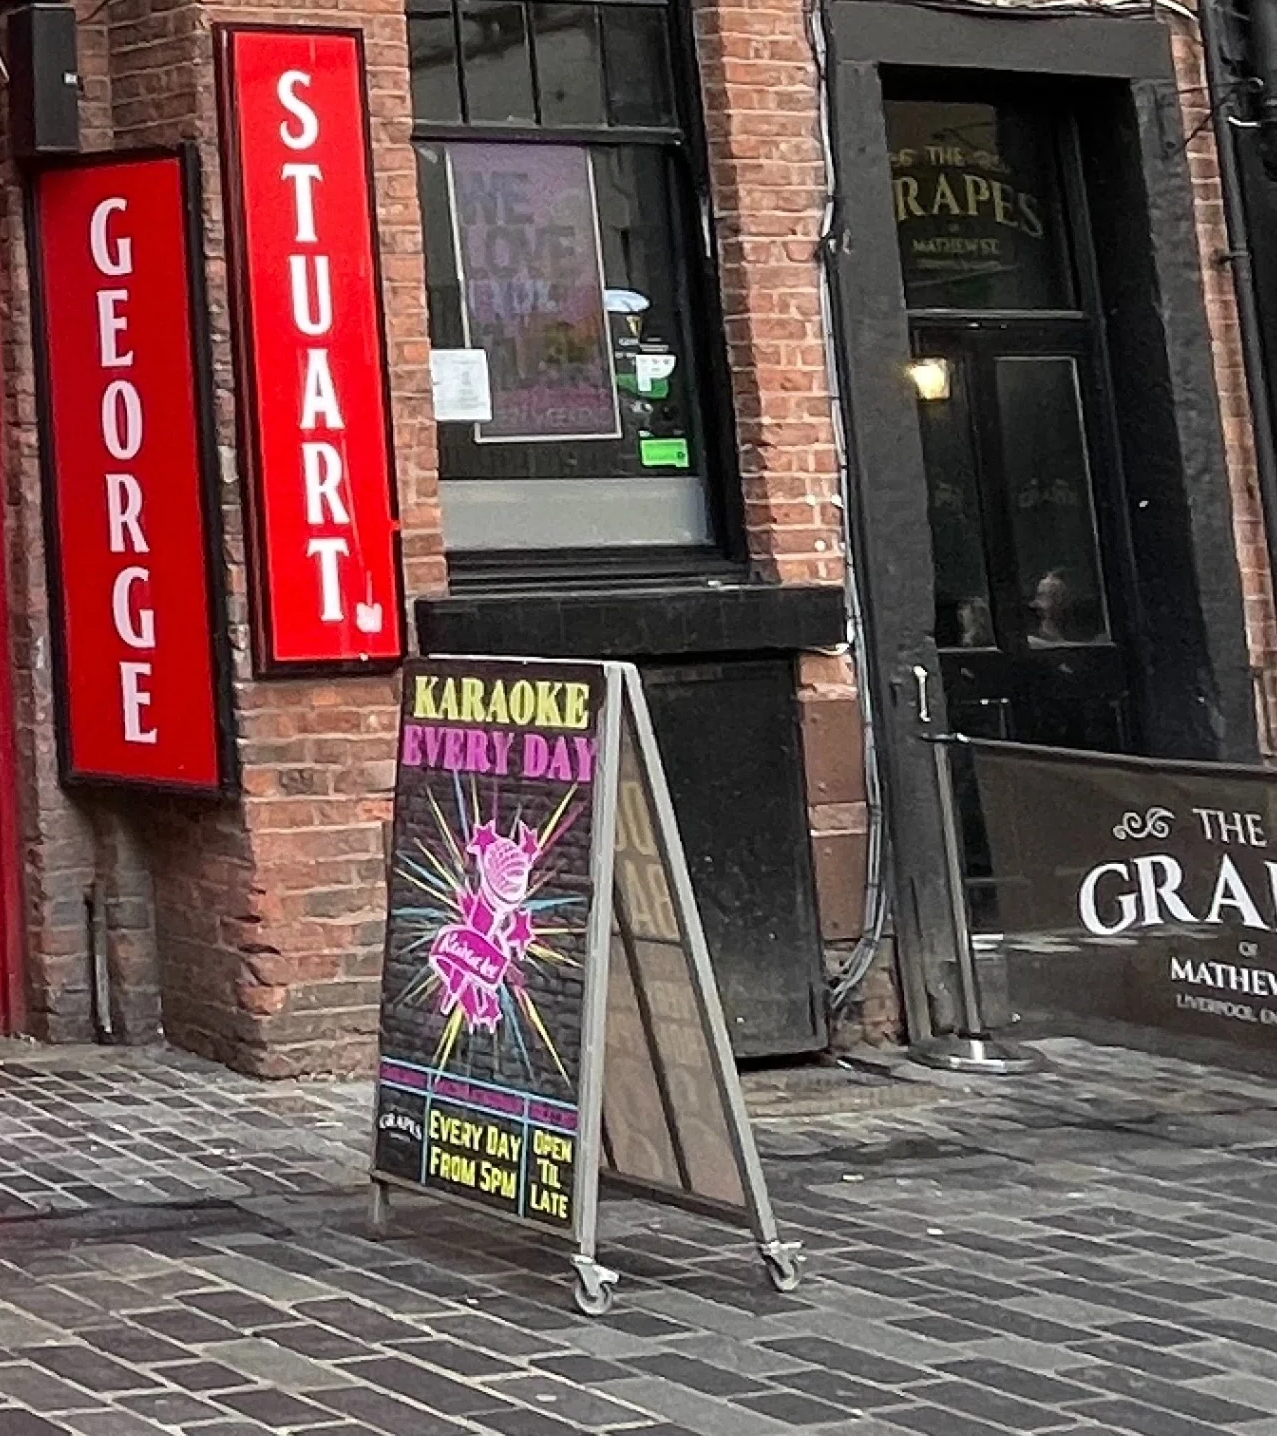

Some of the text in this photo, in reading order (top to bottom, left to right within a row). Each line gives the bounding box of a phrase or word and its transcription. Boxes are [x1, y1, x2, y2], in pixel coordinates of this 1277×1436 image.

[924, 146, 965, 167] THE
[892, 173, 1044, 239] RAPES
[277, 70, 351, 624] STUART
[89, 197, 158, 746] GEORGE
[413, 675, 589, 730] KARAOKE
[402, 724, 598, 783] EVERY DAY
[1192, 807, 1267, 847] THE
[1079, 853, 1277, 935] GRA
[430, 1110, 521, 1163] EVERY DAY
[533, 1129, 572, 1163] OPEN
[430, 1145, 518, 1199] FROM 5PM
[530, 1183, 569, 1219] LATE
